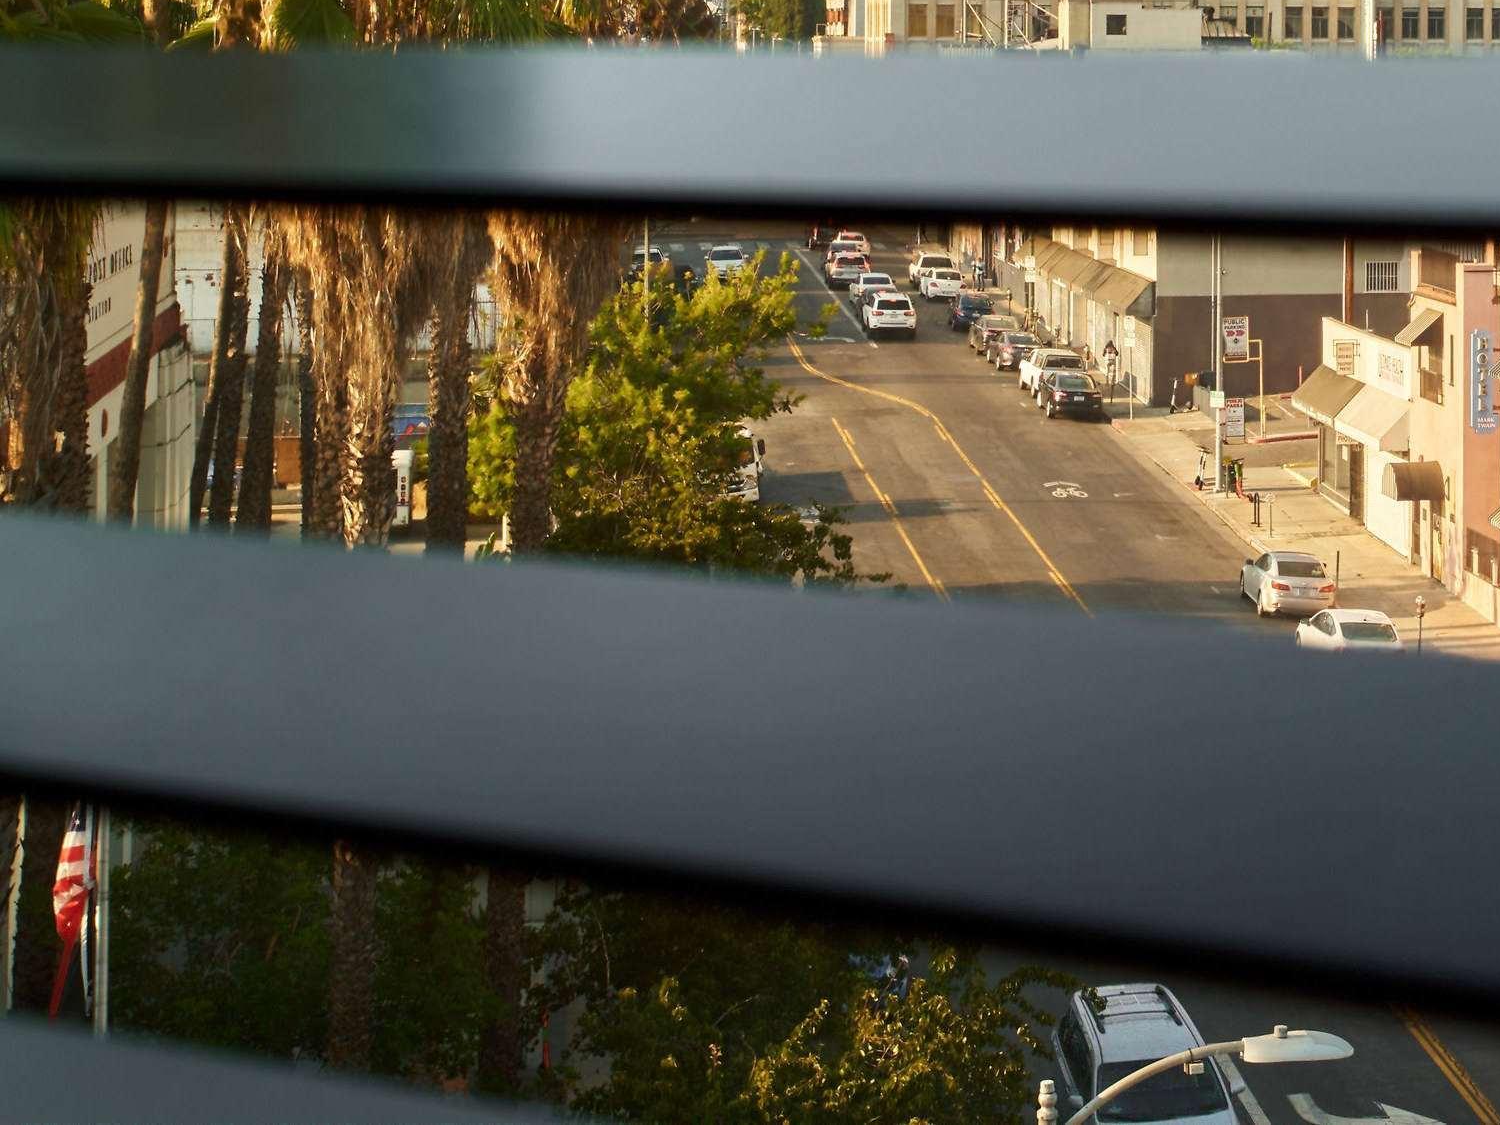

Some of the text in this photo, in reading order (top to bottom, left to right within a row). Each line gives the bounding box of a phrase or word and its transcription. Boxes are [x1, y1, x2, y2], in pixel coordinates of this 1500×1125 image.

[88, 244, 133, 283] POST OFFICE
[1223, 318, 1245, 326] PUBLIC
[1476, 337, 1489, 412] HOTEL
